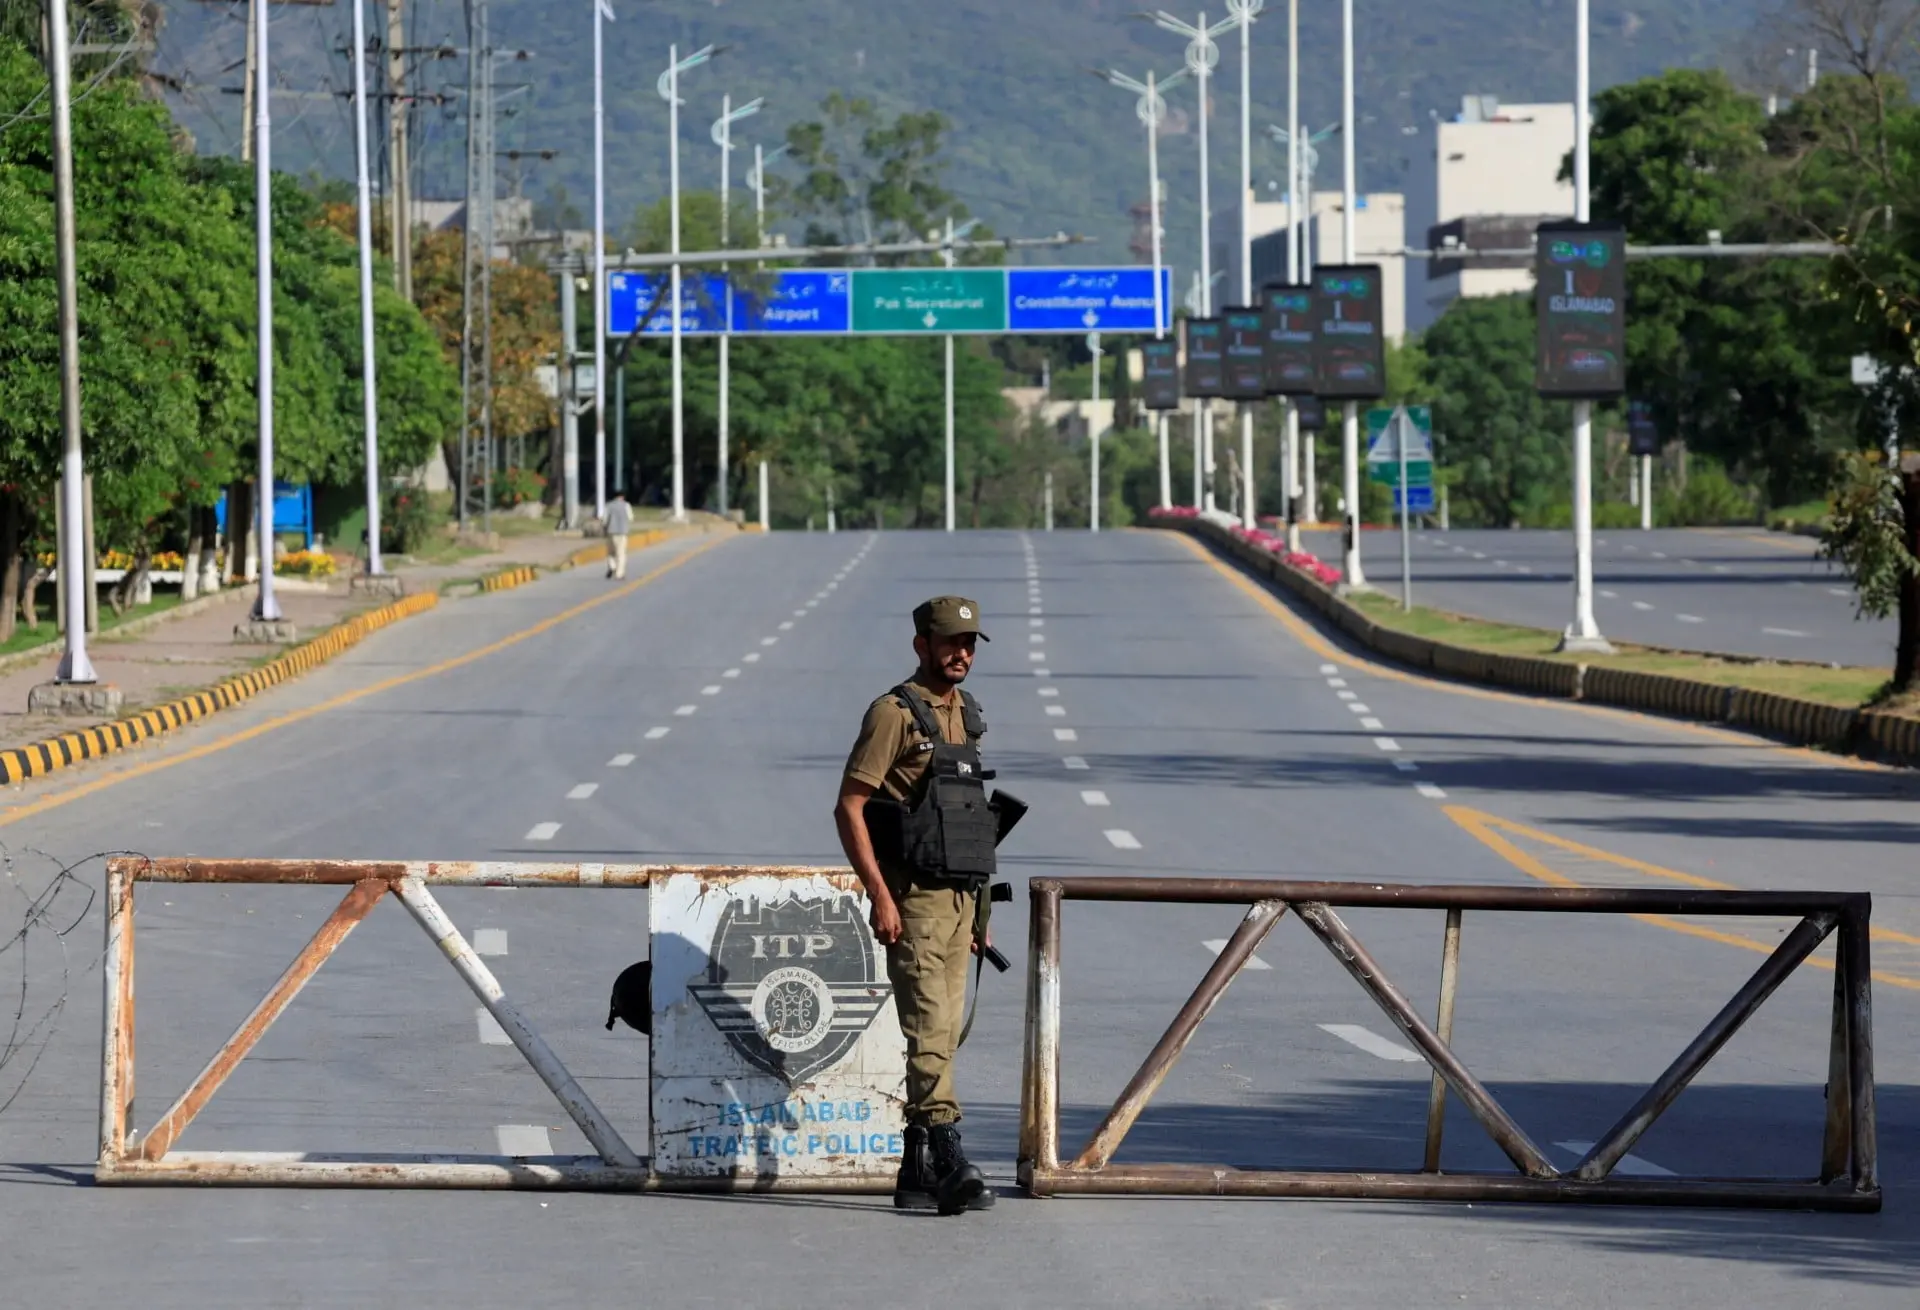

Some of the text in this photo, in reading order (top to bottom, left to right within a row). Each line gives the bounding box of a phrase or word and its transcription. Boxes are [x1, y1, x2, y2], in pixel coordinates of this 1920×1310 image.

[763, 306, 819, 322] Airport
[751, 934, 834, 960] ITP
[719, 1101, 871, 1126] ISLAMABAD
[808, 1132, 902, 1155] POLICE
